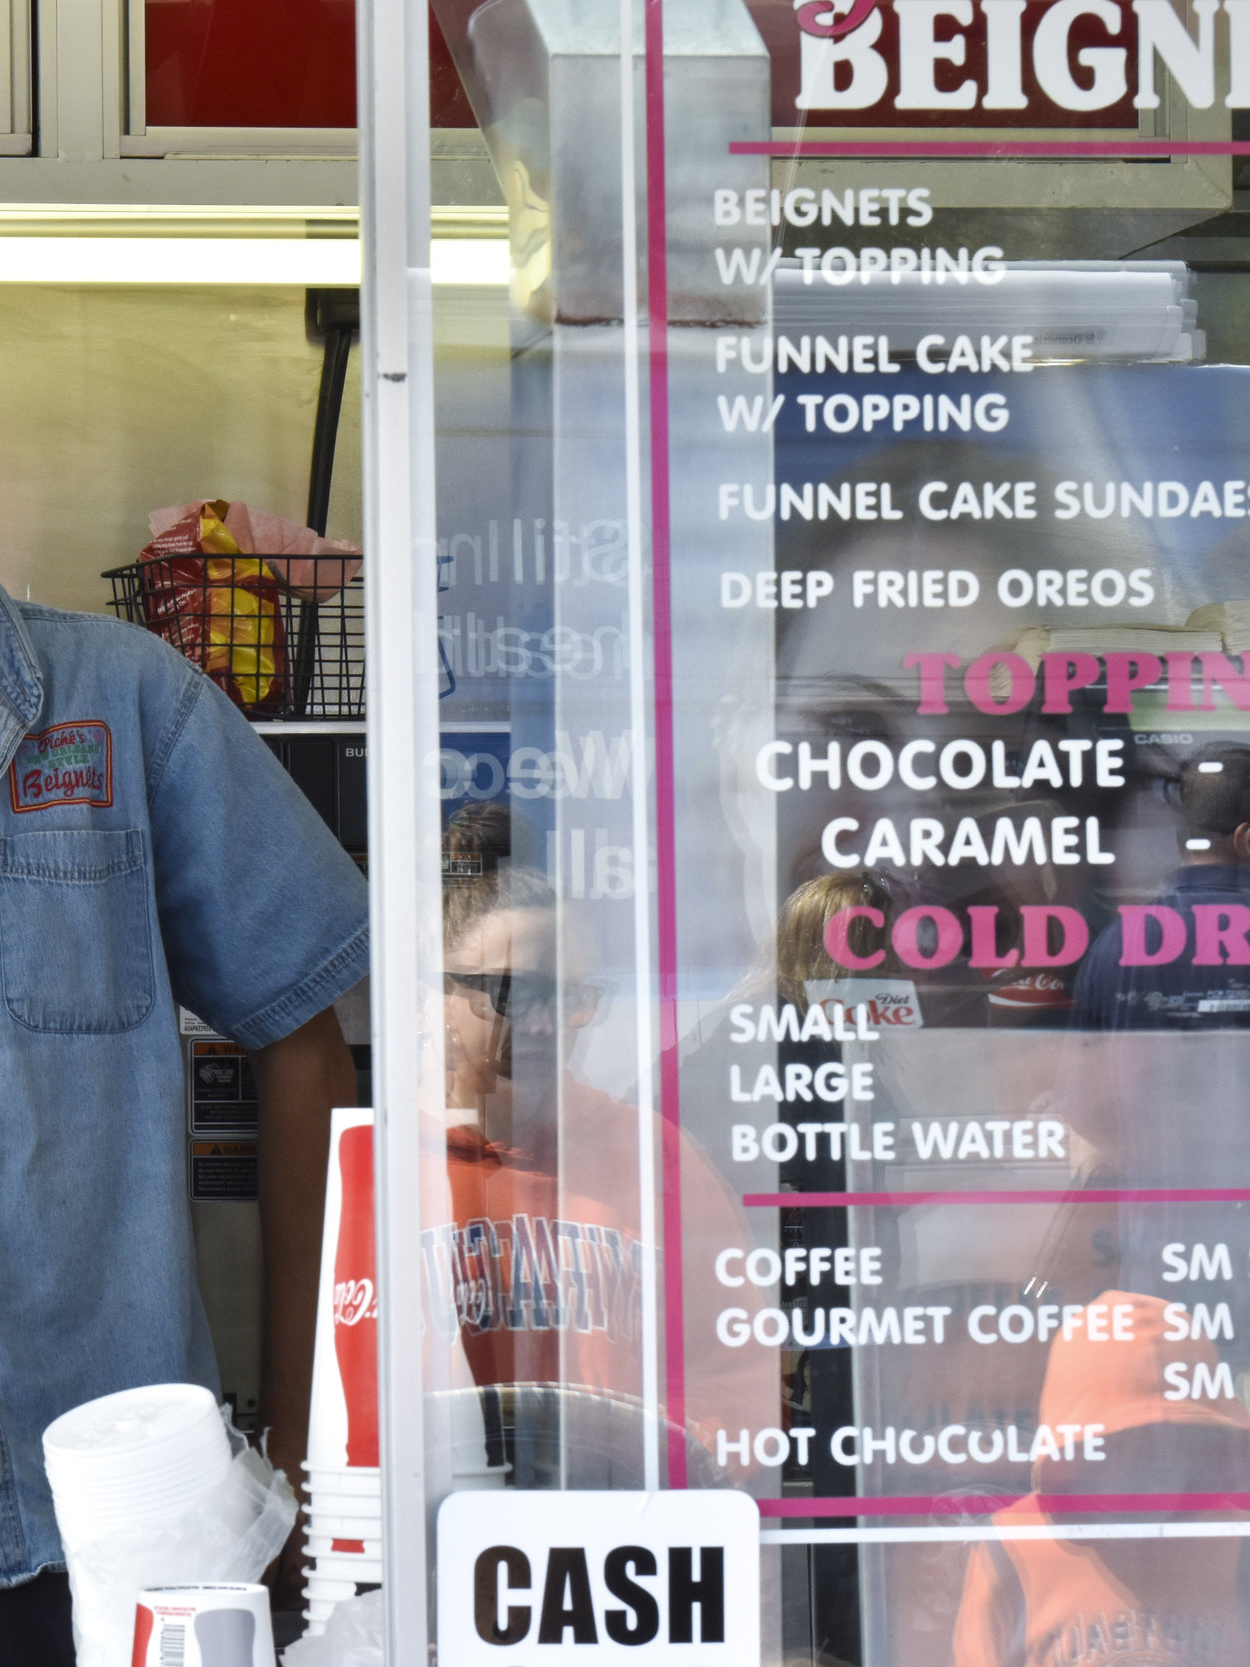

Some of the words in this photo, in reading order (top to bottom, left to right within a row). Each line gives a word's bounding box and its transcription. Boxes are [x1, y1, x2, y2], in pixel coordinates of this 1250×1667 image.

[713, 188, 933, 227] BEIGNETS
[716, 247, 781, 286] W/
[795, 247, 1007, 286] TOPPING
[717, 335, 899, 374] FUNNEL
[916, 335, 1034, 373] CAKE
[717, 395, 783, 432] W/
[796, 395, 1010, 433] TOPPING
[719, 482, 904, 521] FUNNEL
[919, 482, 1037, 520] CAKE
[1054, 482, 1250, 520] SUNDAE
[721, 571, 834, 609] DEEP
[853, 570, 980, 608] FRIED
[997, 569, 1155, 607] OREOS
[1133, 732, 1193, 745] CASIO
[756, 738, 1125, 792] CHOCOLATE
[822, 816, 1115, 867] CARAMEL
[823, 905, 1090, 970] COLD
[819, 998, 915, 1026] Coke
[875, 993, 910, 1005] Diet
[729, 1004, 880, 1043] SMALL
[730, 1063, 875, 1102] LARGE
[732, 1122, 896, 1161] BOTTLE
[911, 1120, 1066, 1159] WATER
[715, 1247, 883, 1288] COFFEE
[1162, 1243, 1233, 1282] SM
[716, 1306, 952, 1347] GOURMET
[967, 1305, 1135, 1344] COFFEE
[1163, 1303, 1235, 1342] SM
[1163, 1362, 1235, 1401] SM
[716, 1428, 816, 1467] HOT
[474, 1545, 725, 1646] CASH
